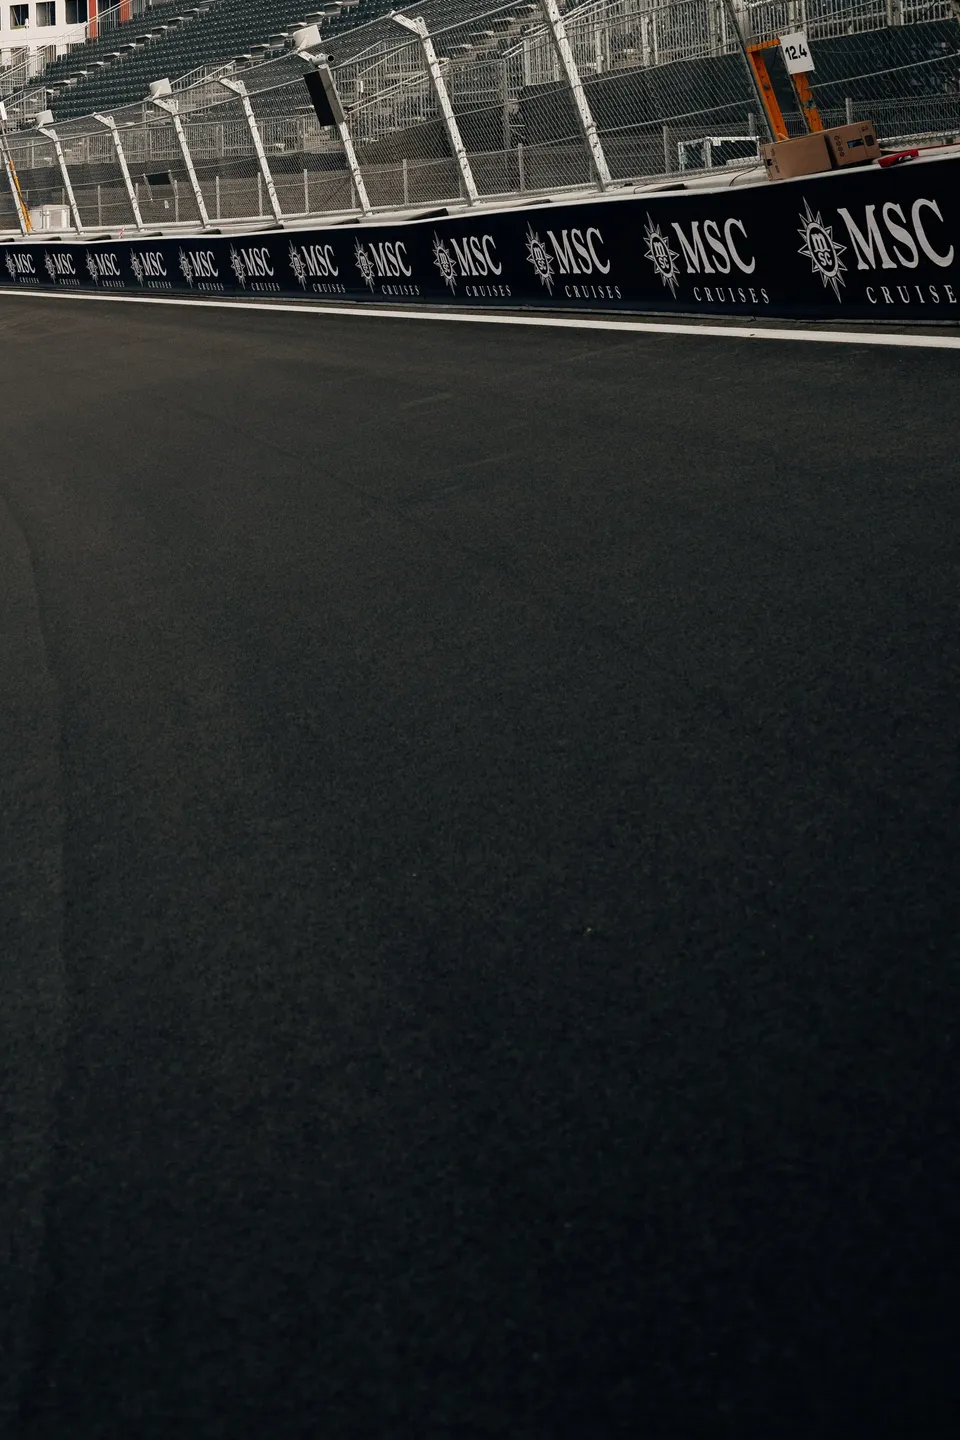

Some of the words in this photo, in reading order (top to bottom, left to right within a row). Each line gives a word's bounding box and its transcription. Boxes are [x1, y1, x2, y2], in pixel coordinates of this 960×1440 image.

[785, 44, 808, 60] 12.4
[837, 198, 954, 270] MSC
[450, 234, 502, 276] MSC
[546, 228, 611, 274] MSC
[672, 218, 756, 274] MSC
[13, 254, 36, 273] MSC
[53, 253, 76, 274] MSC
[95, 253, 120, 276] MSC
[139, 252, 168, 276] MSC
[189, 250, 218, 277] MSC
[241, 248, 274, 276] MSC
[300, 245, 339, 277] MSC
[369, 241, 412, 278] MSC
[102, 280, 125, 288] CRUISES
[148, 280, 172, 289] CRUISES
[198, 282, 224, 291] CRUISES
[251, 282, 280, 292] CRUISES
[312, 283, 346, 293] CRUISES
[382, 284, 420, 296] CRUISES
[466, 284, 512, 297] CRUISES
[565, 284, 622, 300] CRUISES
[694, 286, 770, 304] CRUISES
